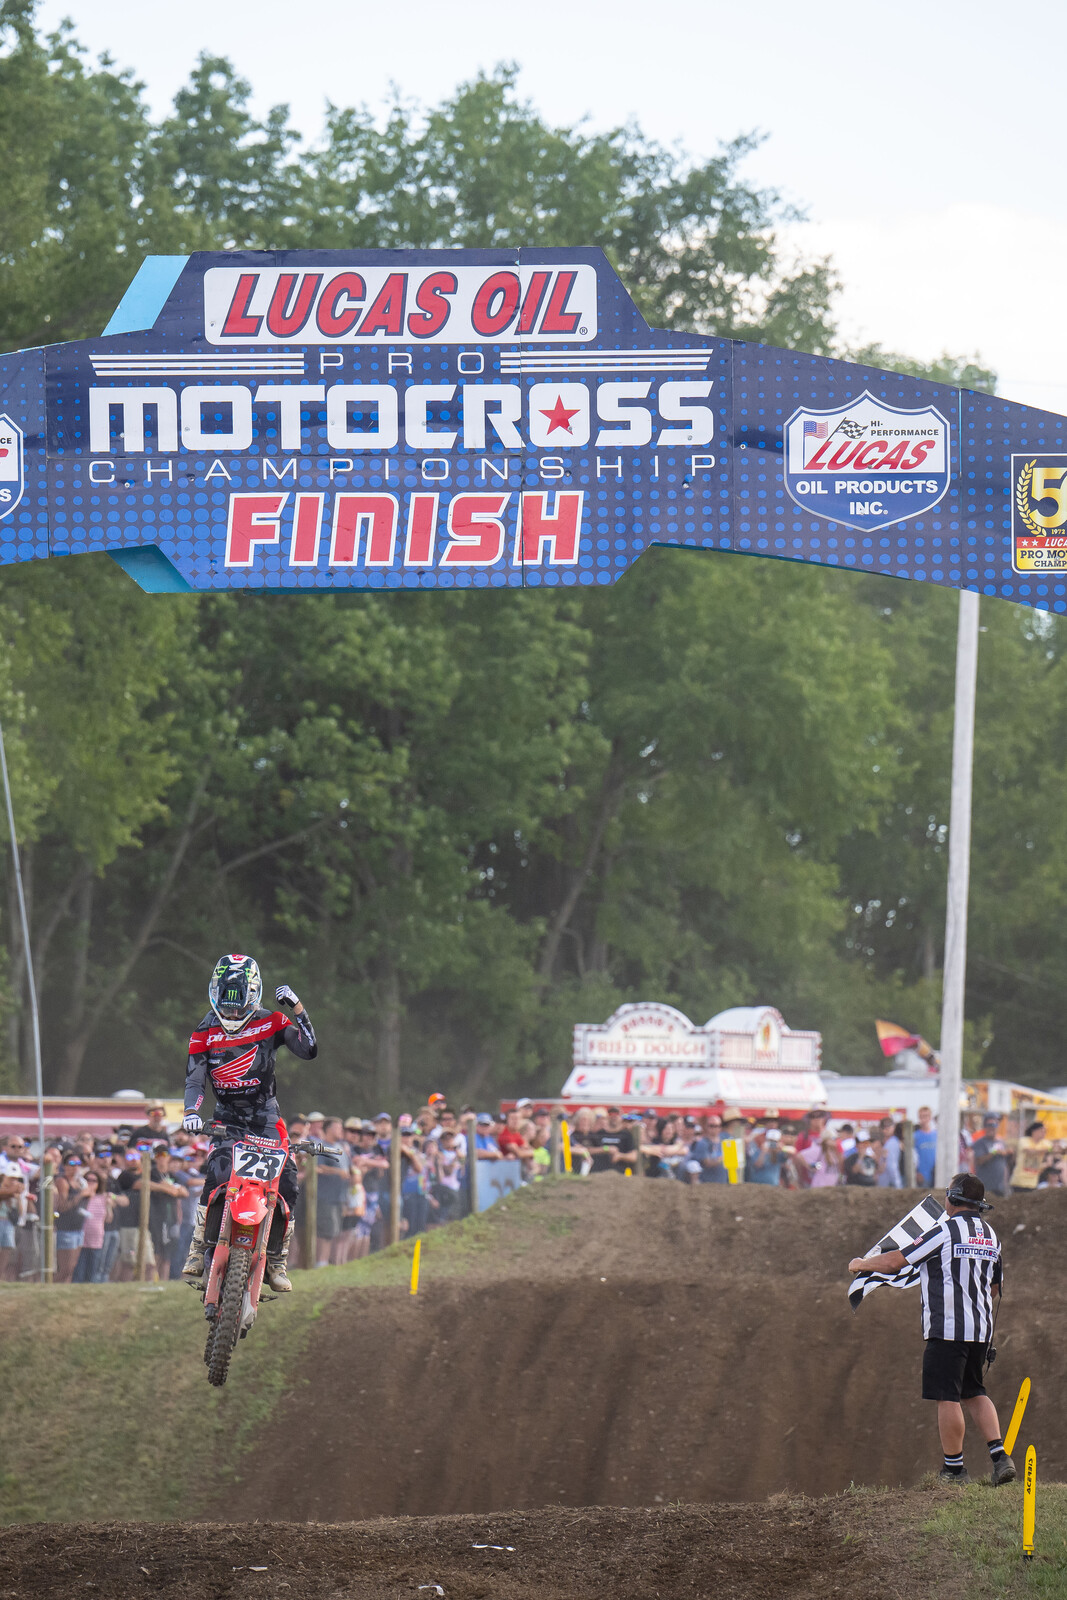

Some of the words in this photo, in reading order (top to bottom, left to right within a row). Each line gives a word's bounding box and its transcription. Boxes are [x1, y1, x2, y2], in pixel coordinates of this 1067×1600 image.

[220, 271, 458, 338] LUCAS
[471, 271, 583, 338] OIL
[320, 352, 485, 375] PRO
[89, 381, 714, 452] MOTOCROSS
[870, 420, 884, 428] HI-
[870, 429, 939, 437] PERFORMANCE
[803, 439, 936, 471] LUCAS
[89, 455, 716, 483] CHAMPIONSHIP
[795, 480, 829, 495] OIL
[834, 480, 939, 494] PRODUCTS
[849, 501, 888, 515] INC.
[224, 490, 585, 568] FINISH
[1020, 550, 1044, 559] PRO
[213, 1078, 261, 1089] HONDA
[235, 1153, 280, 1180] 23
[968, 1237, 984, 1245] LUCAS
